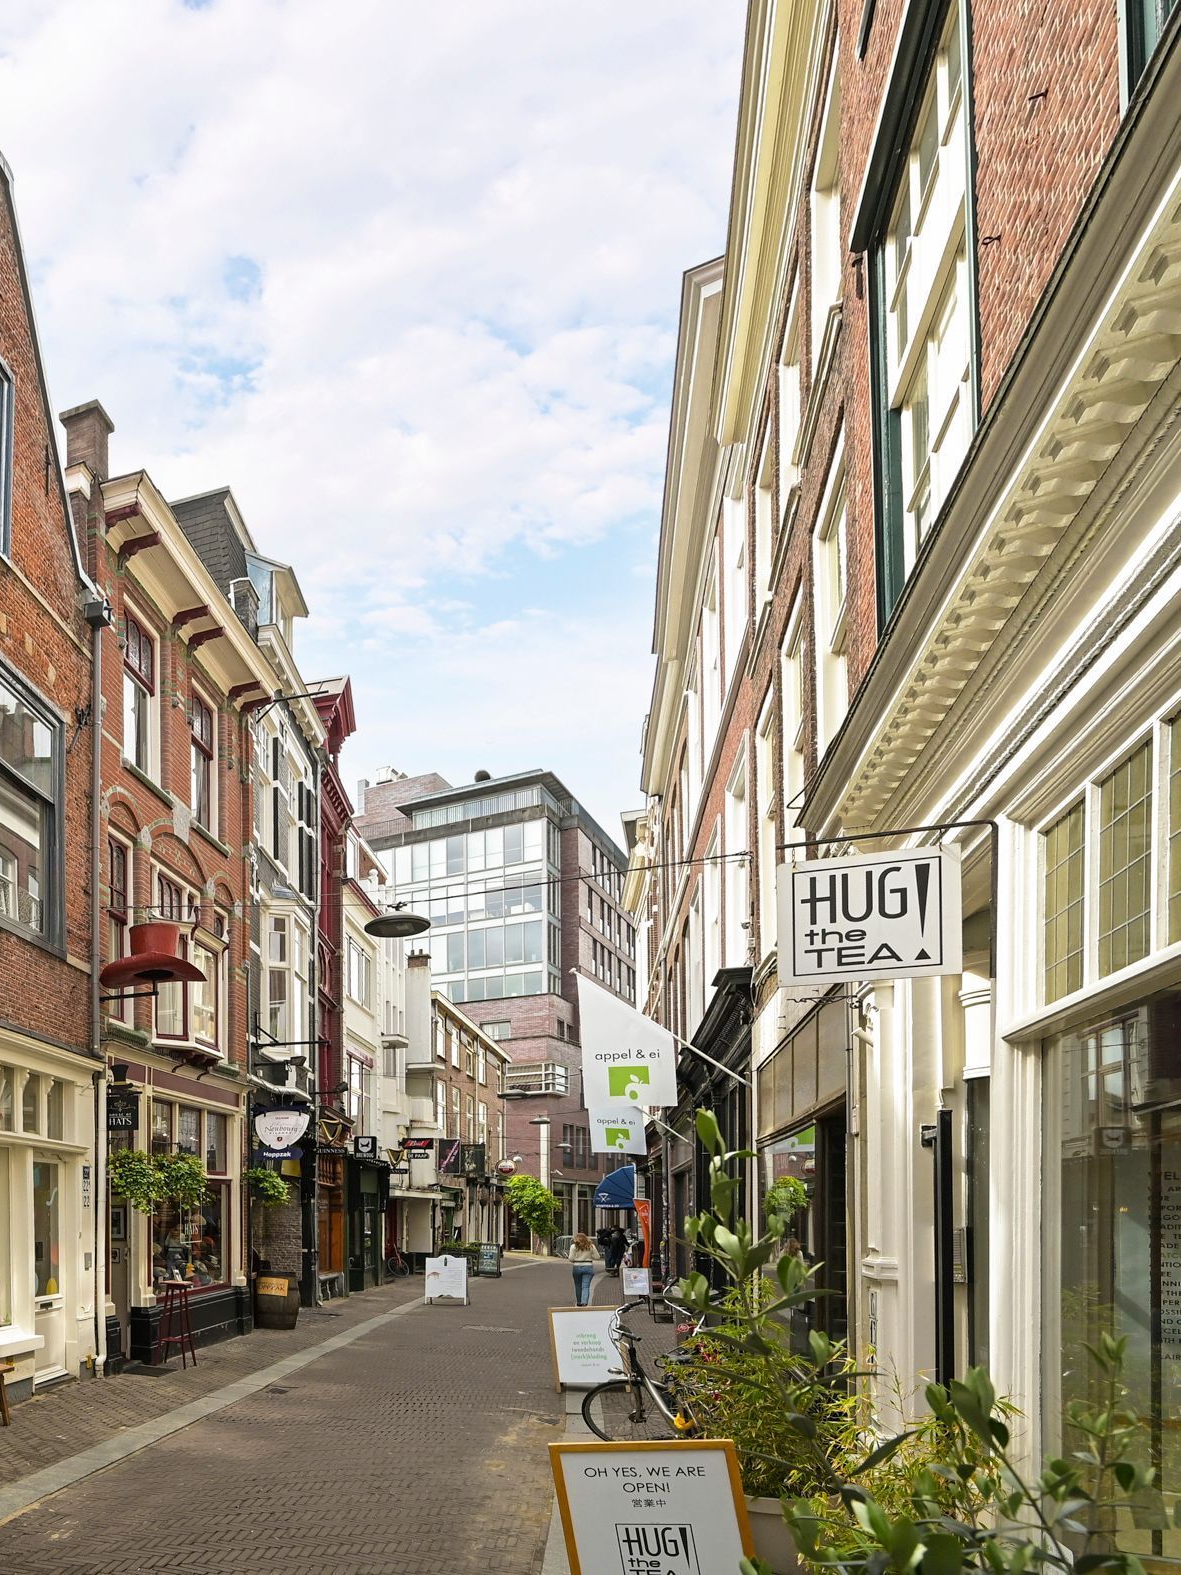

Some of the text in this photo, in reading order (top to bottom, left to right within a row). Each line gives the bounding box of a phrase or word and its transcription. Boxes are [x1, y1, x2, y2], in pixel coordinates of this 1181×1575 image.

[805, 928, 867, 947] the
[804, 943, 903, 969] TEA
[595, 1049, 660, 1062] appel & ei
[109, 1117, 132, 1126] HATS
[596, 1118, 619, 1126] appel
[185, 1223, 198, 1235] HATS
[584, 1466, 707, 1479] OH YES, WE ARE
[622, 1482, 671, 1494] OPEN!
[627, 1557, 661, 1568] the
